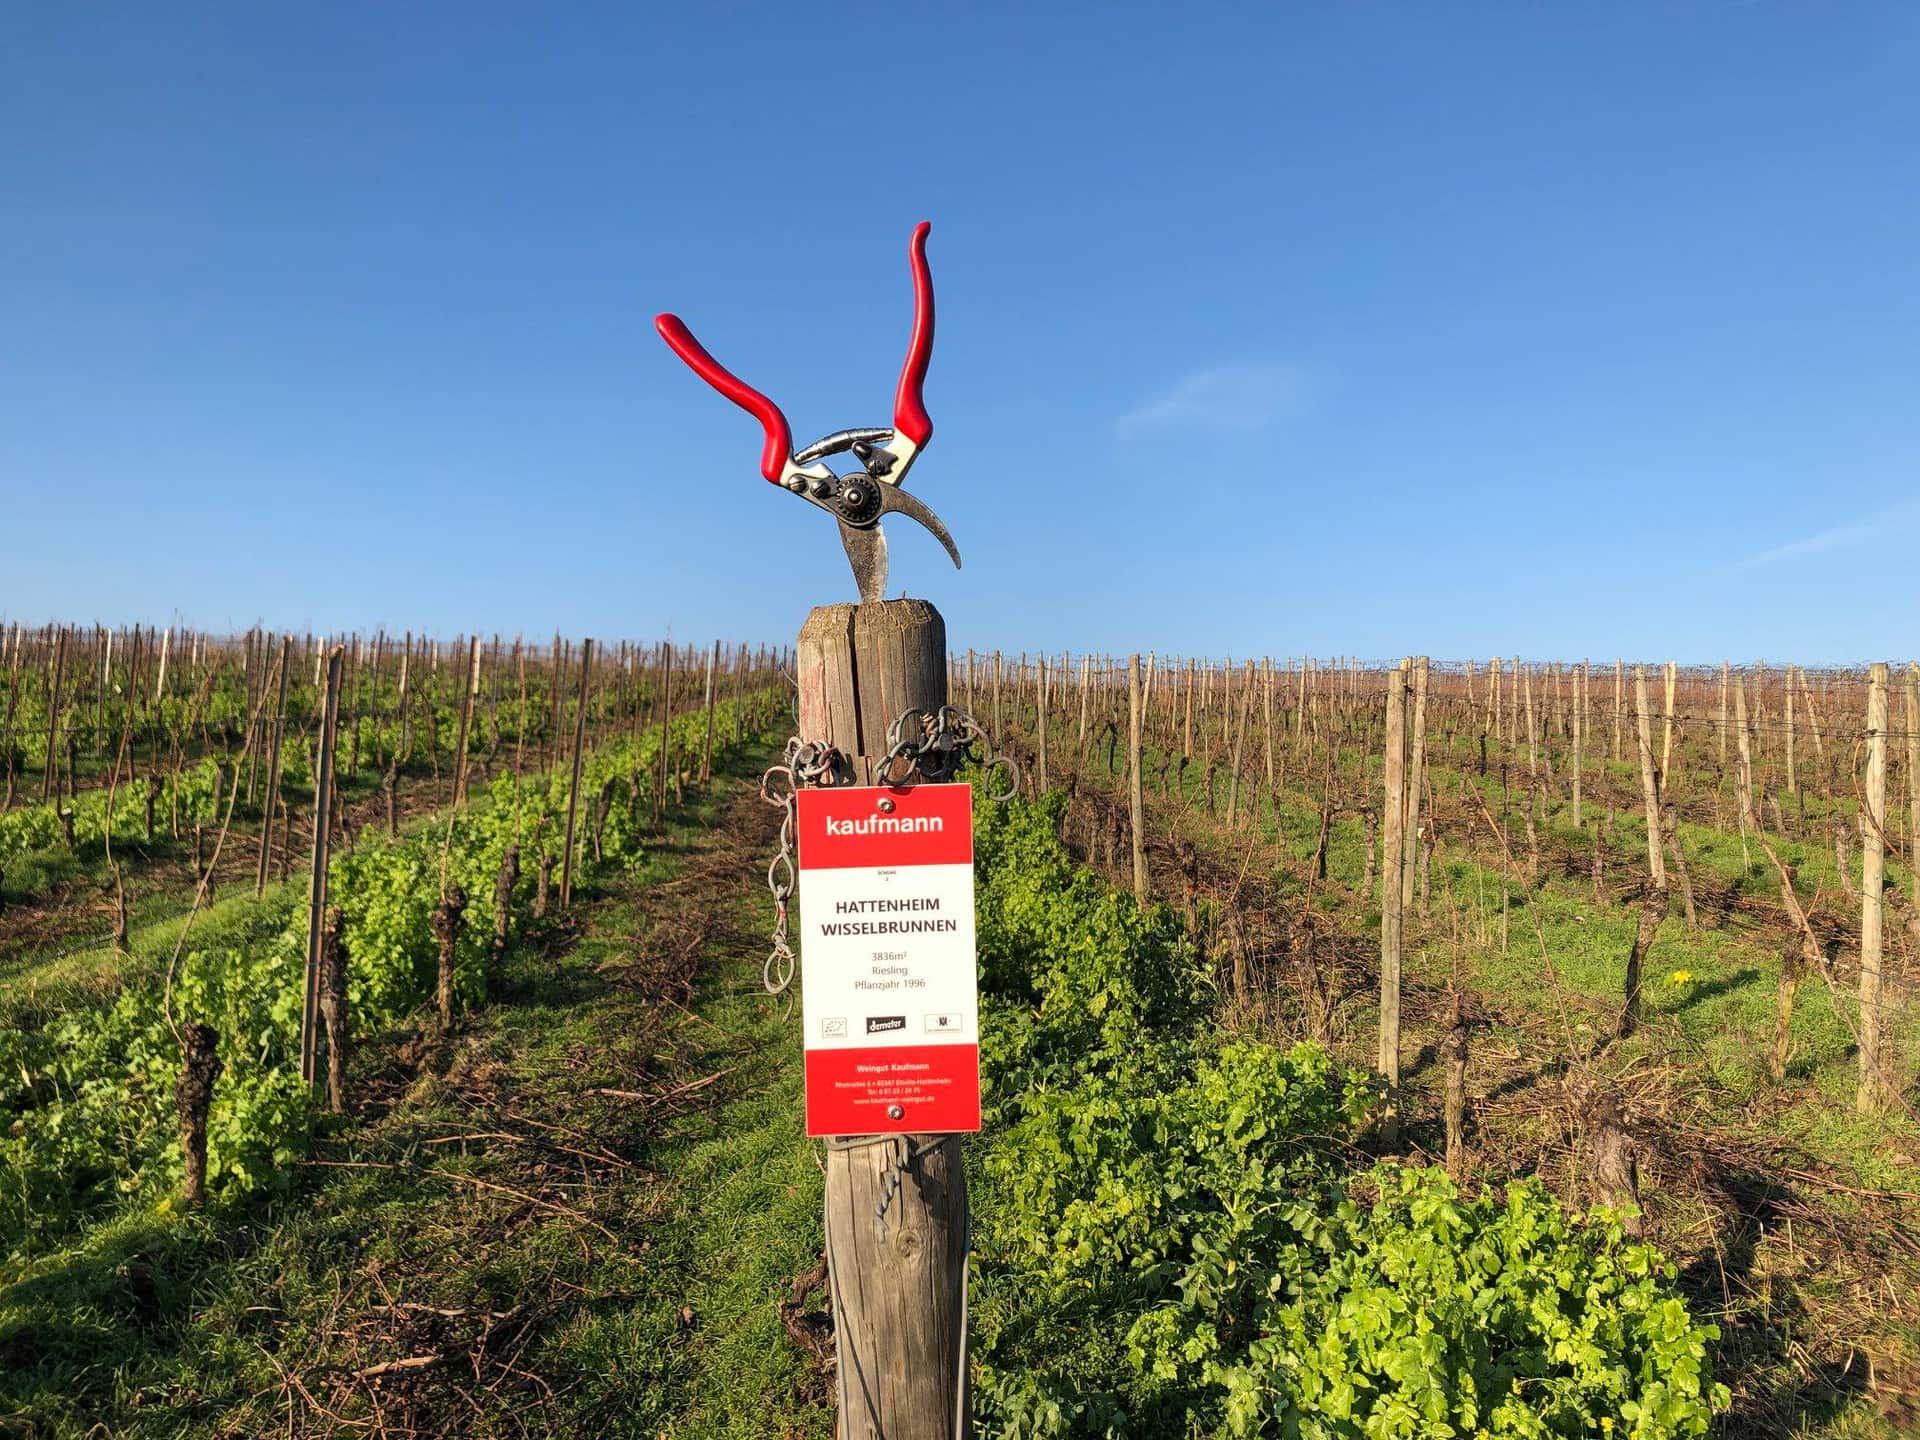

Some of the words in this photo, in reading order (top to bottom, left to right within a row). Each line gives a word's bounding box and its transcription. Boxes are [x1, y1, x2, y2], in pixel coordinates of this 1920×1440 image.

[826, 815, 943, 836] kaufmann
[836, 898, 940, 914] HATTENHEIM
[821, 919, 957, 936] WISSELBRUNNEN
[872, 966, 908, 976] Riesling
[855, 980, 900, 991] Pflanzjahr
[904, 979, 926, 988] 1996
[857, 1065, 888, 1073] Weingut
[891, 1063, 930, 1071] Kaufmann
